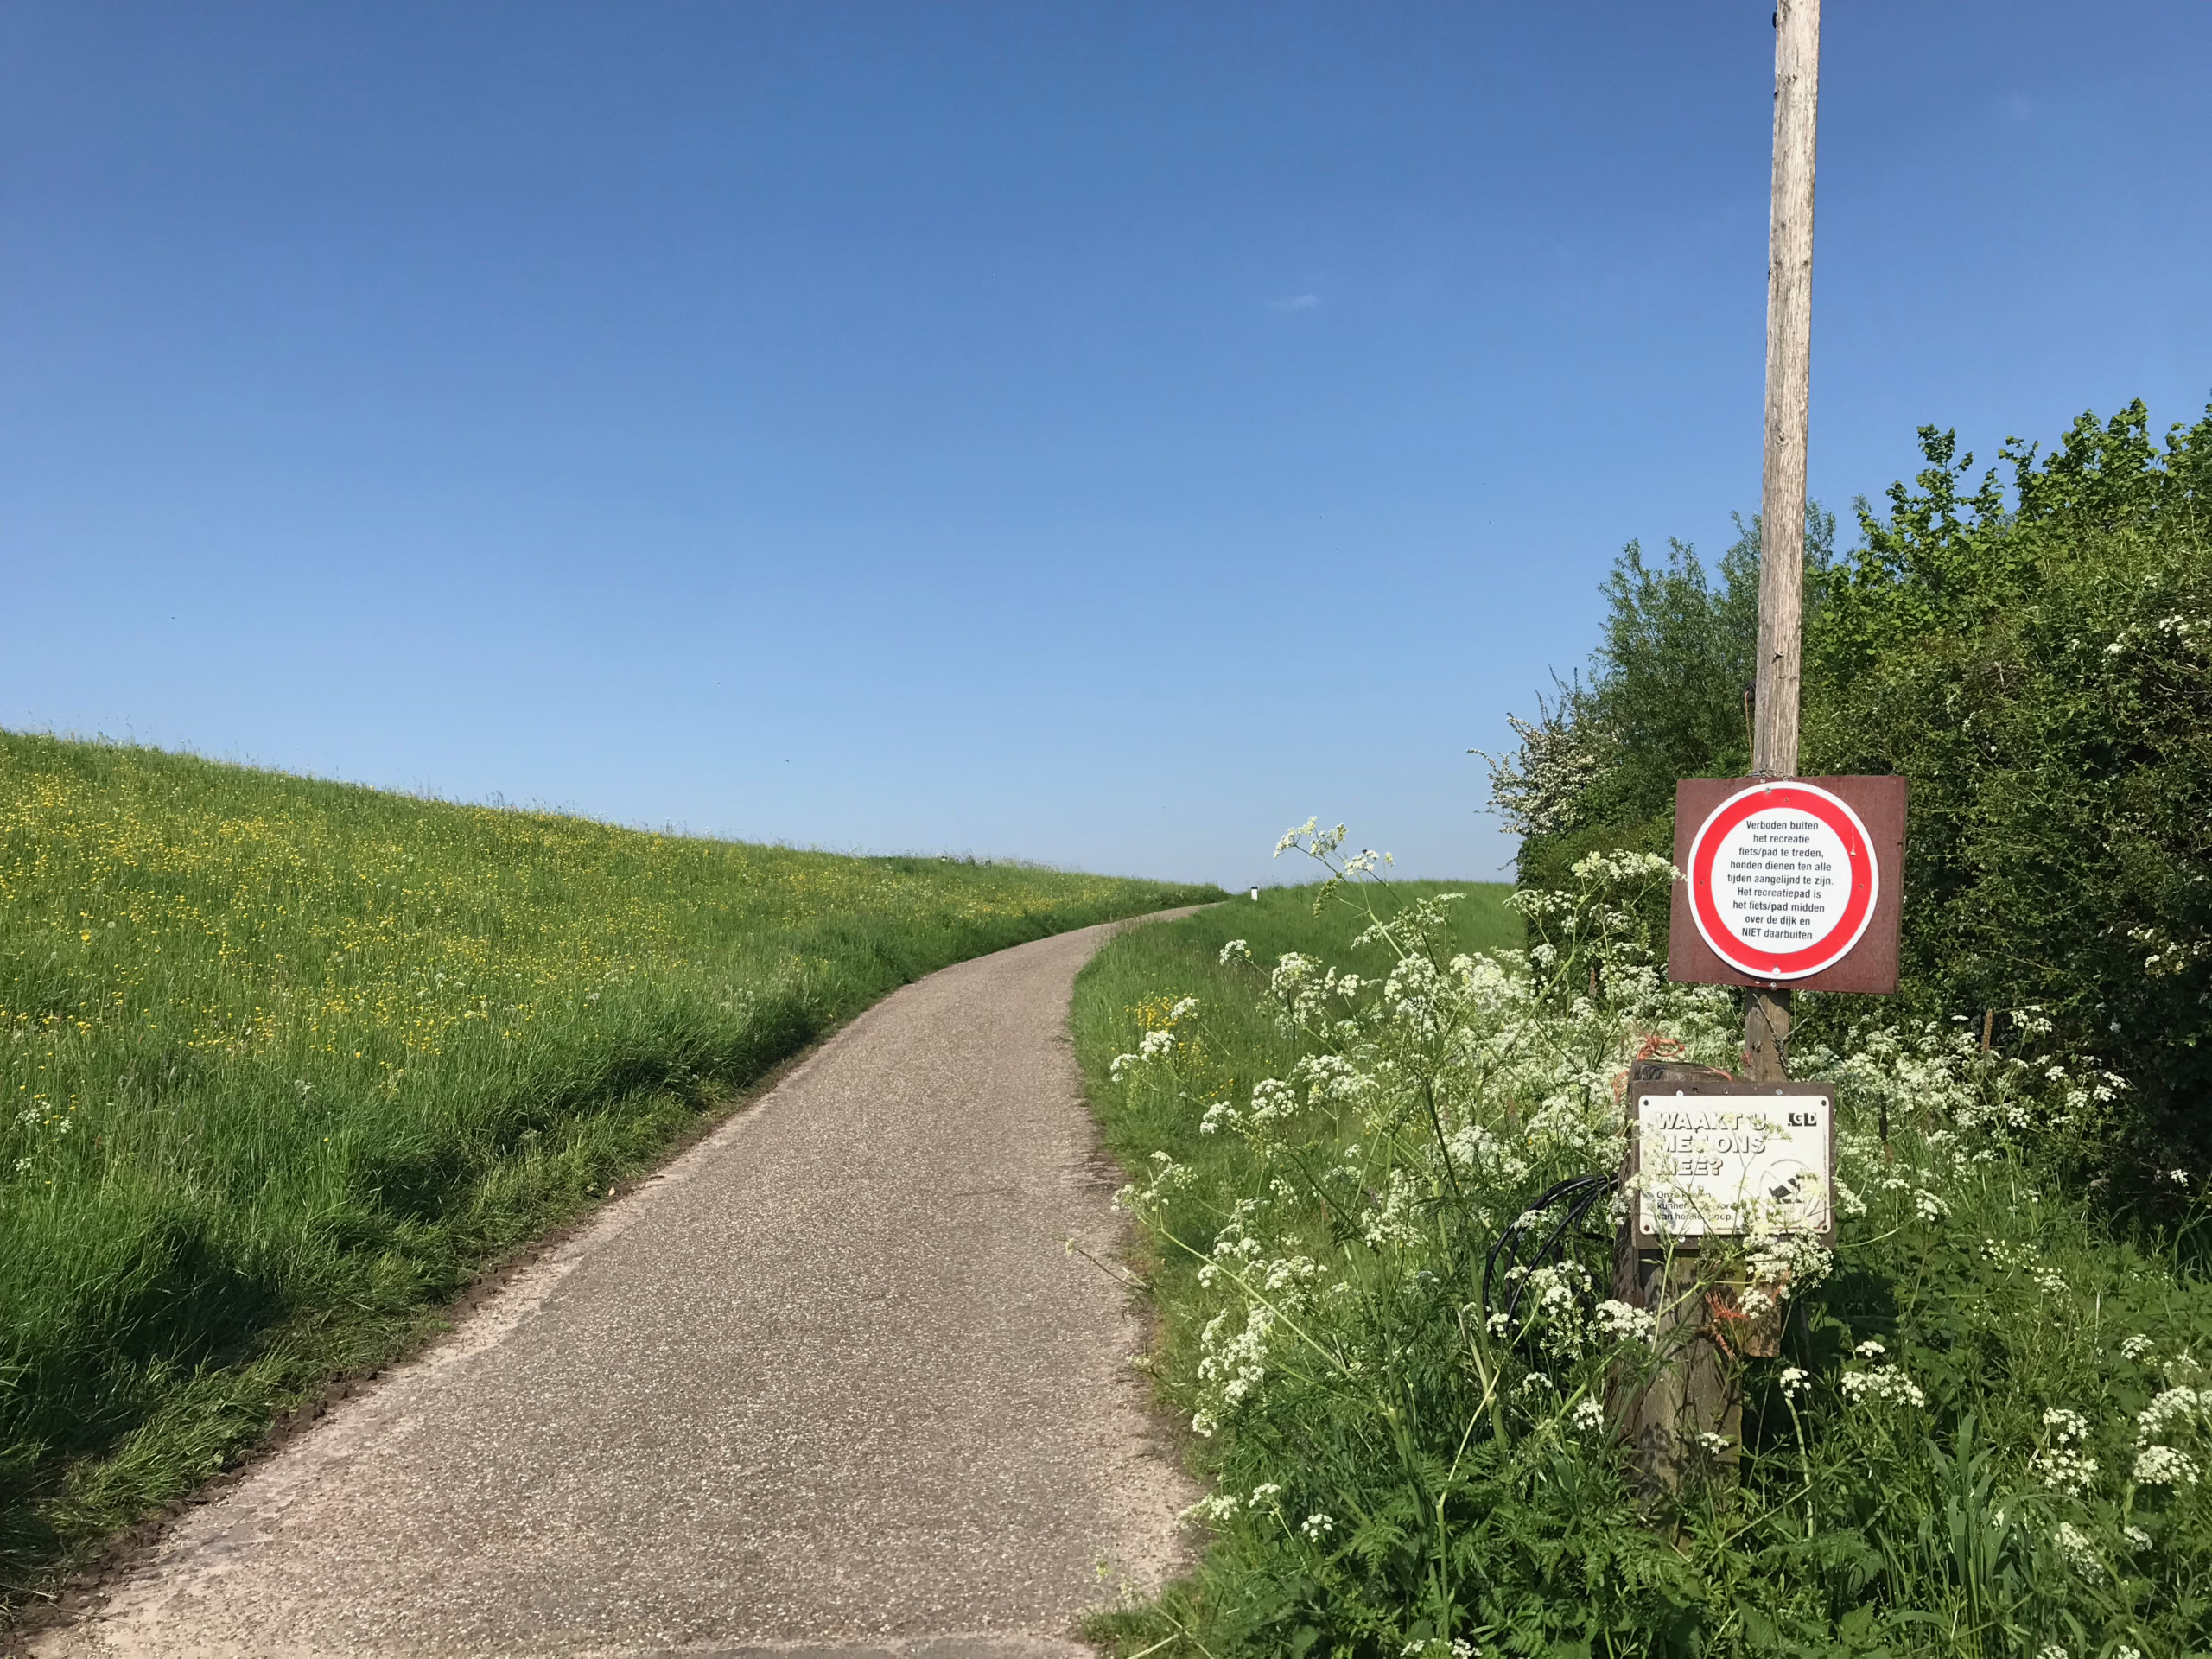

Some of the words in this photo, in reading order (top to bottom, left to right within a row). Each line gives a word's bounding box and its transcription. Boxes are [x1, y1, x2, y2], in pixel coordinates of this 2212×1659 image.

[1739, 848, 1777, 857] fiets/pad
[1792, 849, 1823, 858] treden,
[1731, 861, 1762, 869] honden
[1765, 861, 1795, 870] dienen
[1728, 874, 1751, 883] tijden
[1754, 875, 1800, 885] aangelijnd
[1815, 876, 1834, 886] zijn.
[1738, 887, 1751, 896] Het
[1754, 889, 1810, 899] recreatiepad
[1750, 901, 1788, 912] fiets/pad
[1791, 903, 1824, 912] midden
[1780, 916, 1796, 926] dijk
[1742, 928, 1761, 937] NIET
[1764, 930, 1812, 939] daarbuiten
[1656, 1113, 1743, 1130] WAAKT
[1713, 1135, 1765, 1153] ONS
